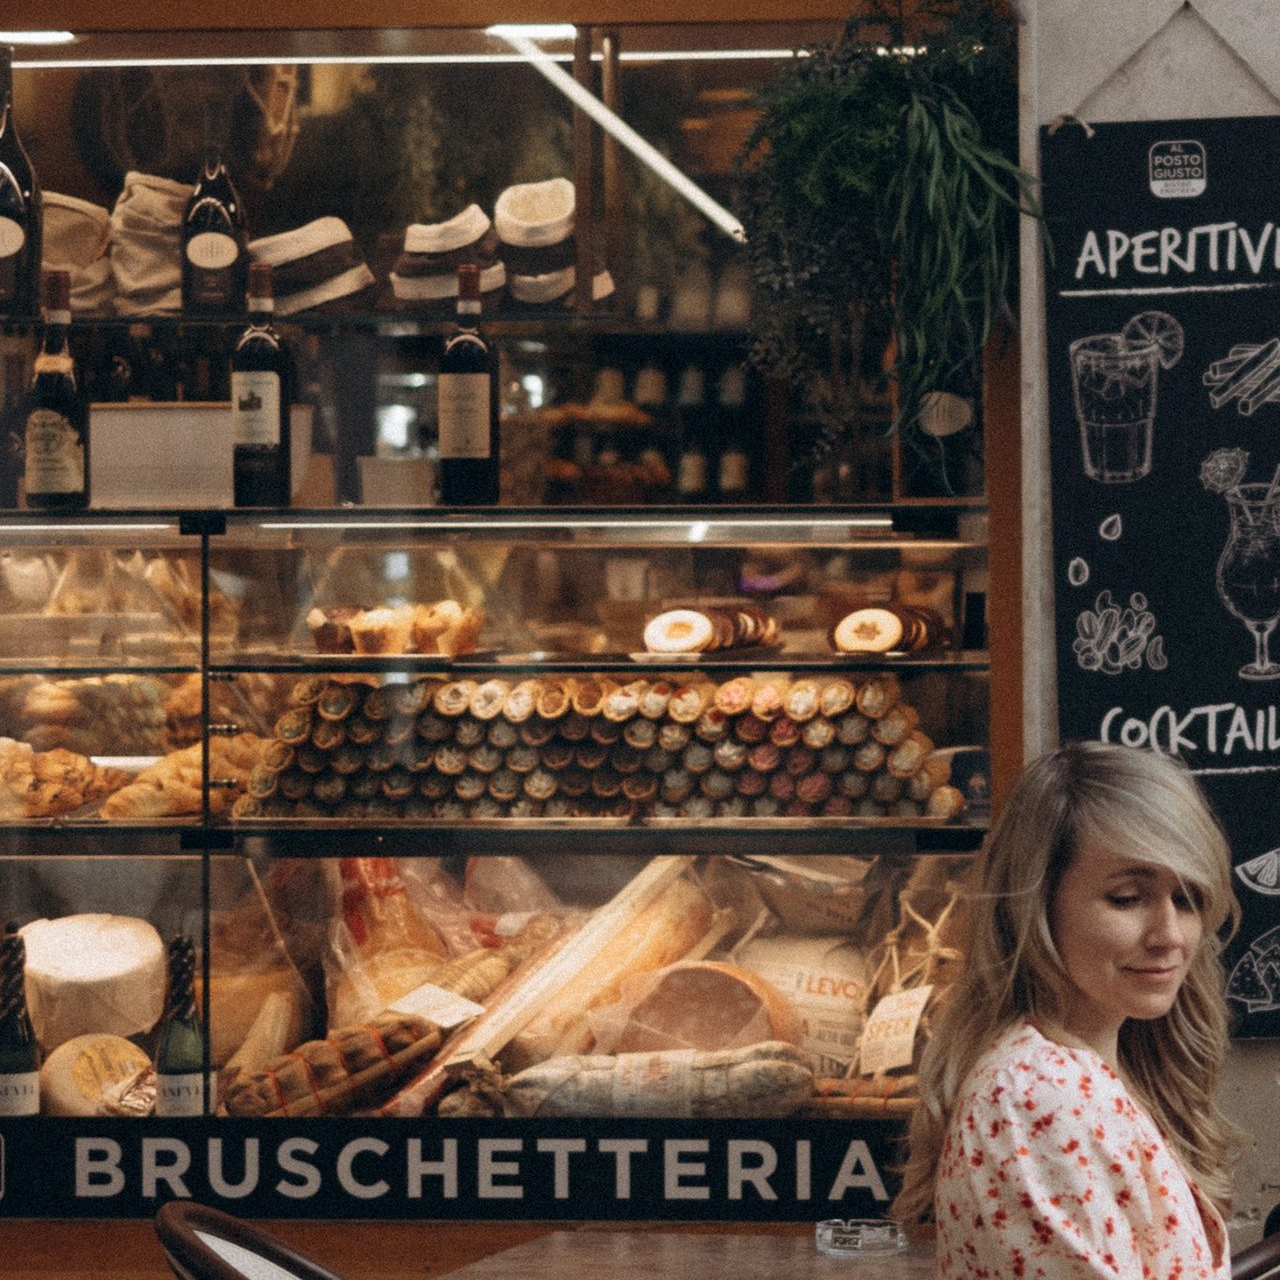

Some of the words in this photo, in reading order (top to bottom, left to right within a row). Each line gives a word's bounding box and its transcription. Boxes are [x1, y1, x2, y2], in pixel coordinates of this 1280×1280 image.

[1170, 144, 1184, 152] AL
[1154, 155, 1201, 166] POSTO
[1154, 167, 1201, 179] GIUSTO
[76, 1137, 888, 1200] BRUSCHETTERIA
